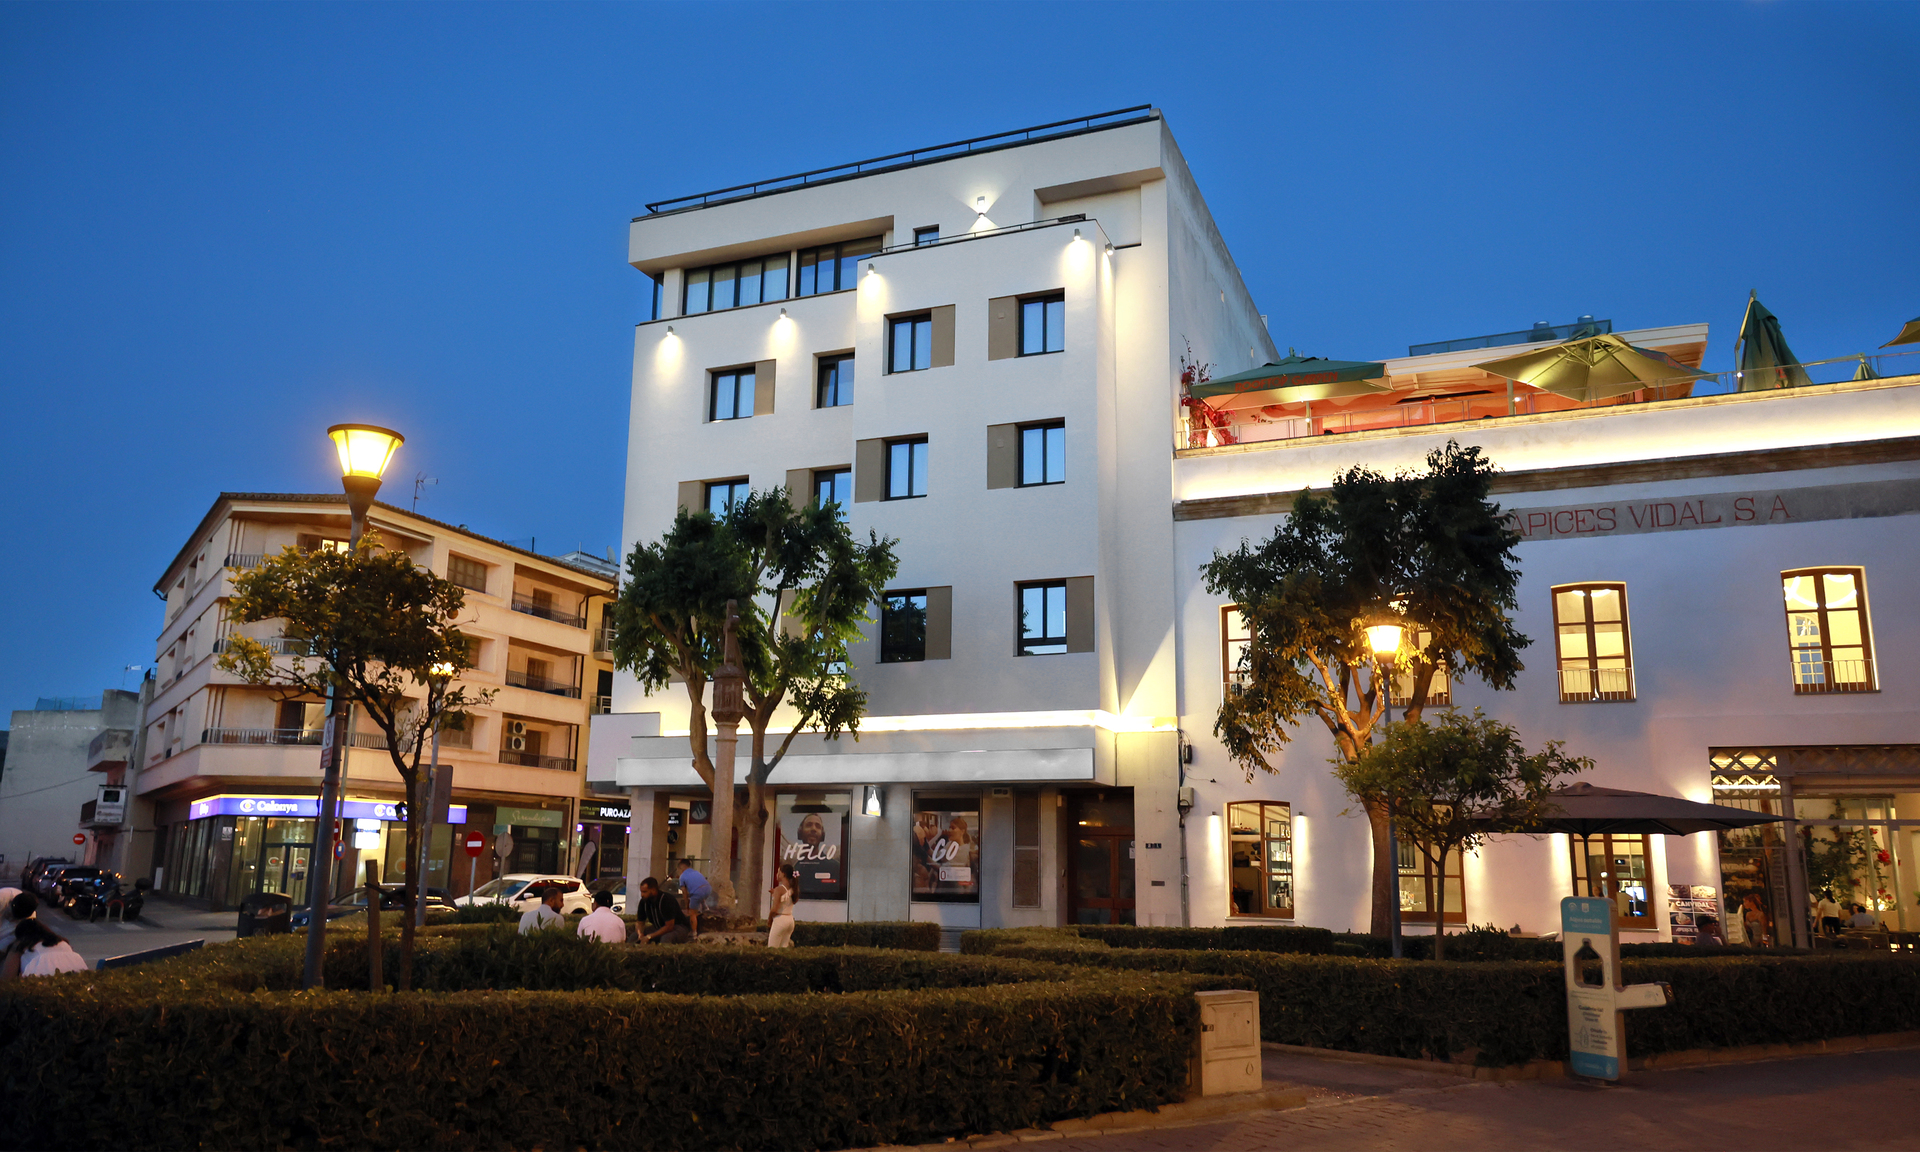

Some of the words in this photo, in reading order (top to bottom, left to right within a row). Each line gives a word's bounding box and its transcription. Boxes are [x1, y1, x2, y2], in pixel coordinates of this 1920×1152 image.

[1235, 376, 1288, 392] ROOFTOP
[1291, 371, 1338, 386] GARDEN
[1493, 508, 1617, 536] APICES
[1628, 500, 1722, 528] VIDAL
[784, 843, 837, 860] HELLO
[932, 838, 959, 862] GO
